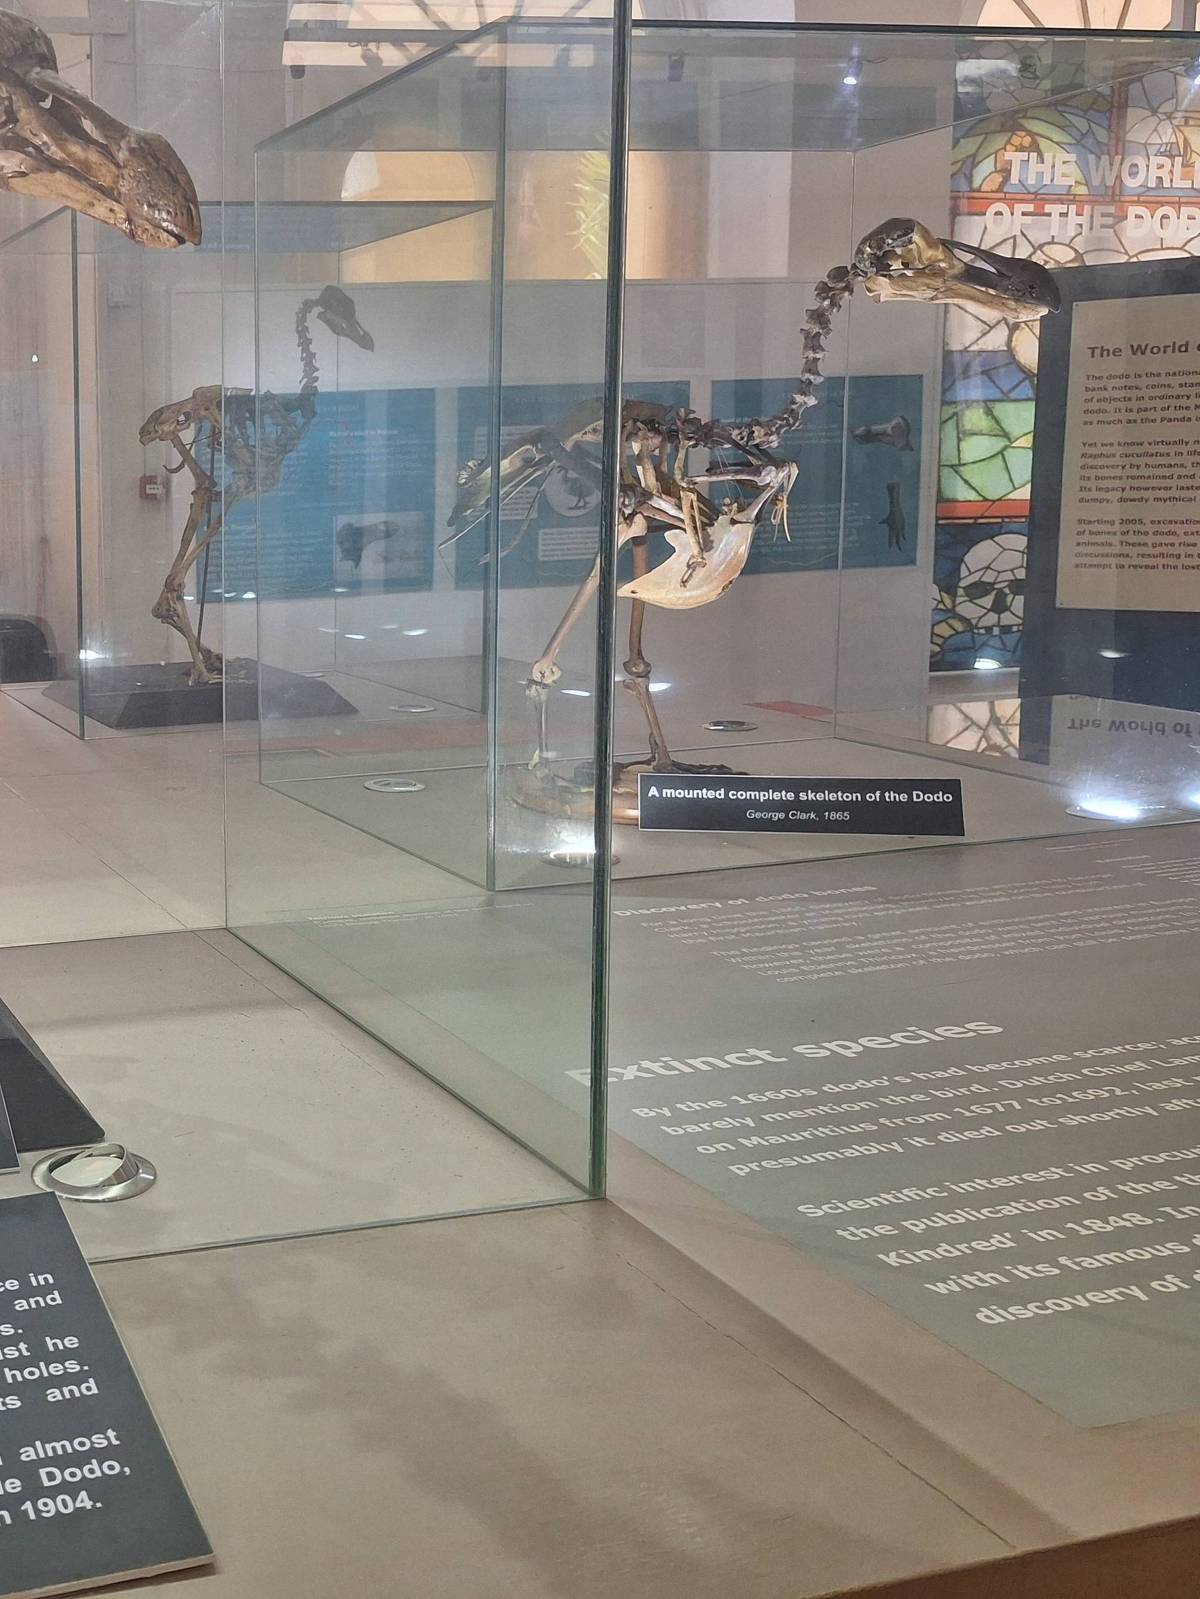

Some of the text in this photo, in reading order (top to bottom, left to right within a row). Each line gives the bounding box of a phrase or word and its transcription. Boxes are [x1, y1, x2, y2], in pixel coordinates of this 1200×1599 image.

[1005, 152, 1077, 186] THE
[986, 202, 1035, 236] OF
[1044, 204, 1115, 236] THE
[1088, 341, 1189, 358] The World
[648, 786, 952, 802] A mounted complete skeleton of the Dodo
[747, 810, 850, 821] George Clark, 1865
[613, 902, 722, 917] Discovery
[756, 894, 808, 902] dodo
[810, 886, 877, 895] bones
[565, 1022, 1003, 1087] Extinct species
[632, 1107, 671, 1117] By
[675, 1101, 727, 1111] the
[730, 1089, 818, 1104] 1660s
[910, 1067, 968, 1079] had
[964, 1055, 1072, 1072] become
[1073, 1042, 1167, 1057] scarce;
[660, 1061, 1152, 1135] barely mention the bird. Dutch Chief
[697, 1143, 736, 1153] on
[737, 1123, 878, 1147] Mauritius
[878, 1113, 952, 1127] from
[953, 1100, 1021, 1116] 1677
[1133, 1078, 1194, 1090] last
[728, 1106, 1159, 1176] presumably it died out shortly
[797, 1164, 1109, 1216] Scientific interest in
[835, 1181, 1179, 1240] the publication of the
[1021, 1229, 1066, 1241] in
[1064, 1213, 1165, 1235] 1848.
[29, 1273, 54, 1286] in
[924, 1242, 1191, 1294] with its famous
[14, 1290, 62, 1310] and
[976, 1275, 1191, 1324] discovery of
[45, 1337, 79, 1351] he
[4, 1360, 89, 1383] holes.
[46, 1378, 99, 1401] and
[19, 1428, 120, 1461] almost
[39, 1459, 130, 1486] Dodo,
